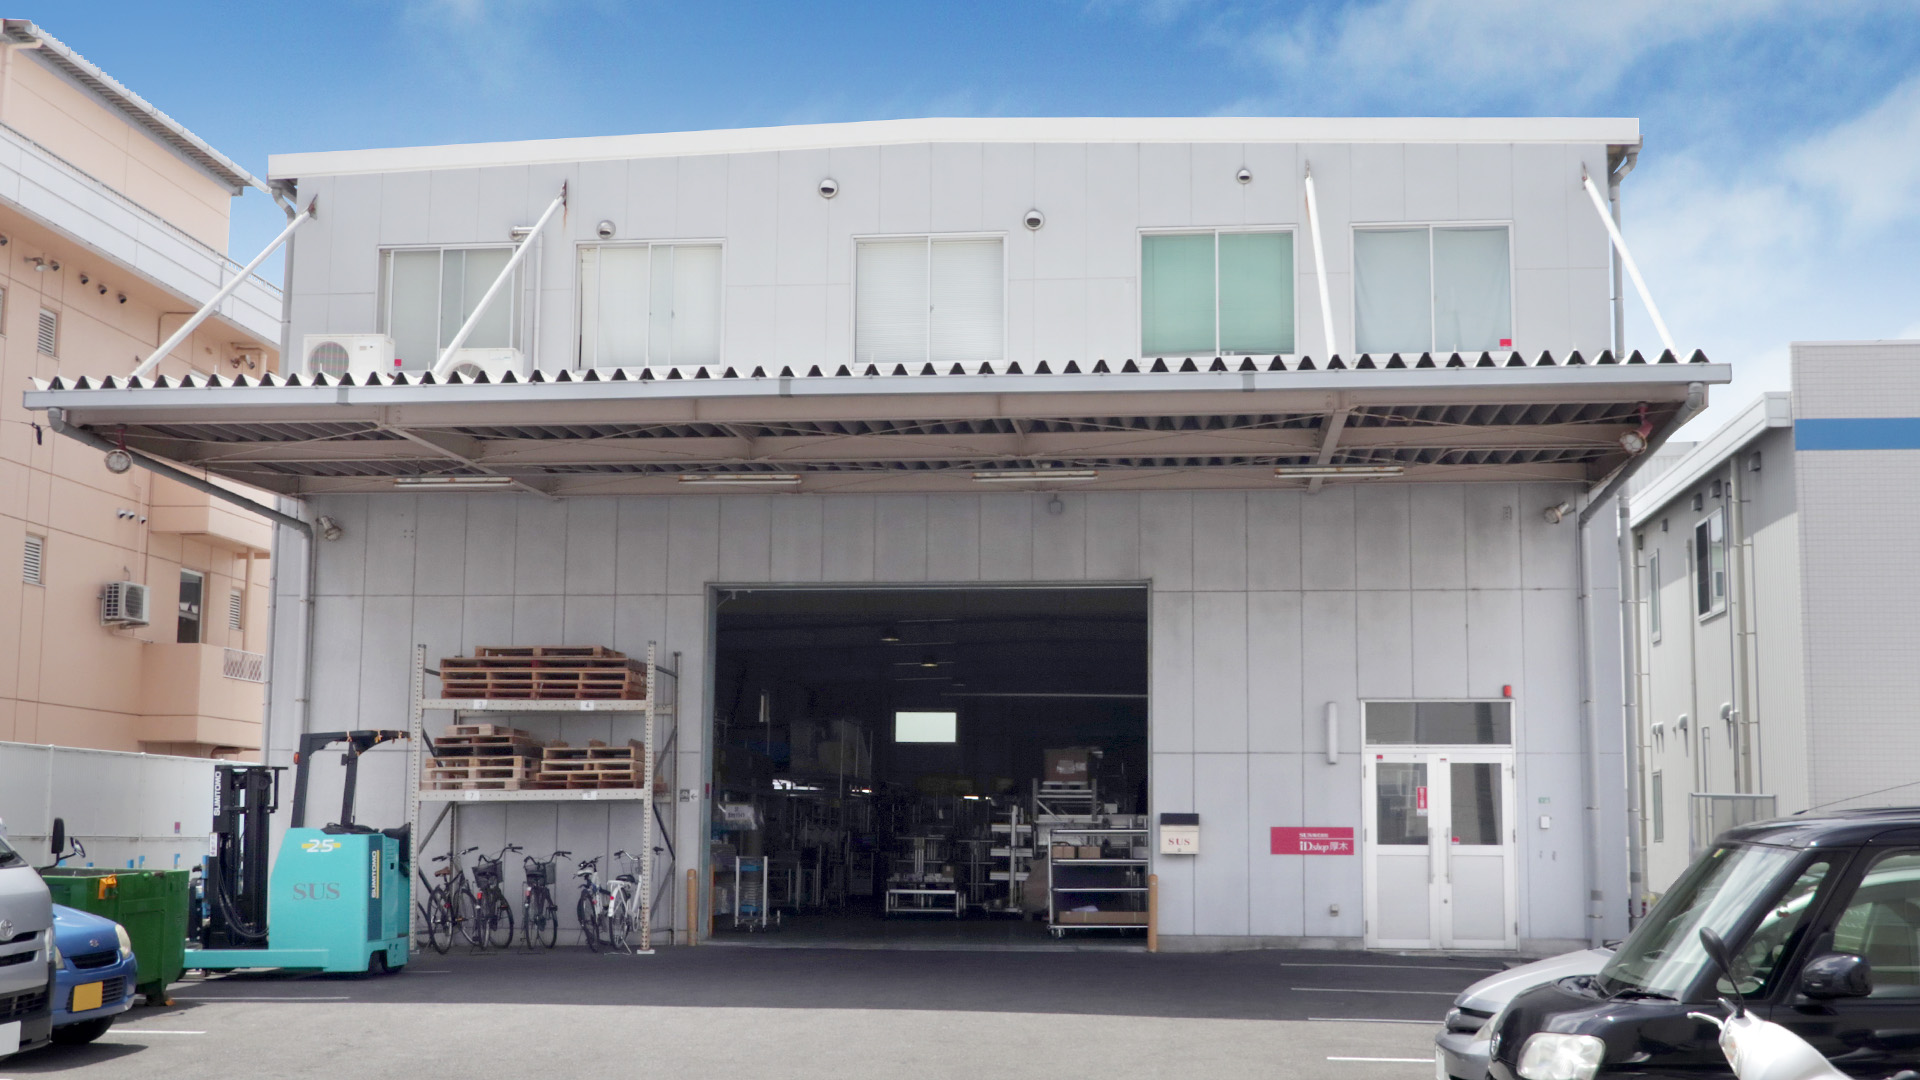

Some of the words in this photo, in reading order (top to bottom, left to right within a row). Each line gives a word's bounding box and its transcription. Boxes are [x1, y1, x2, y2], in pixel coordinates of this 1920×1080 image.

[213, 771, 222, 817] SUMITOMO
[1168, 837, 1191, 846] SUS
[292, 882, 340, 900] SUS
